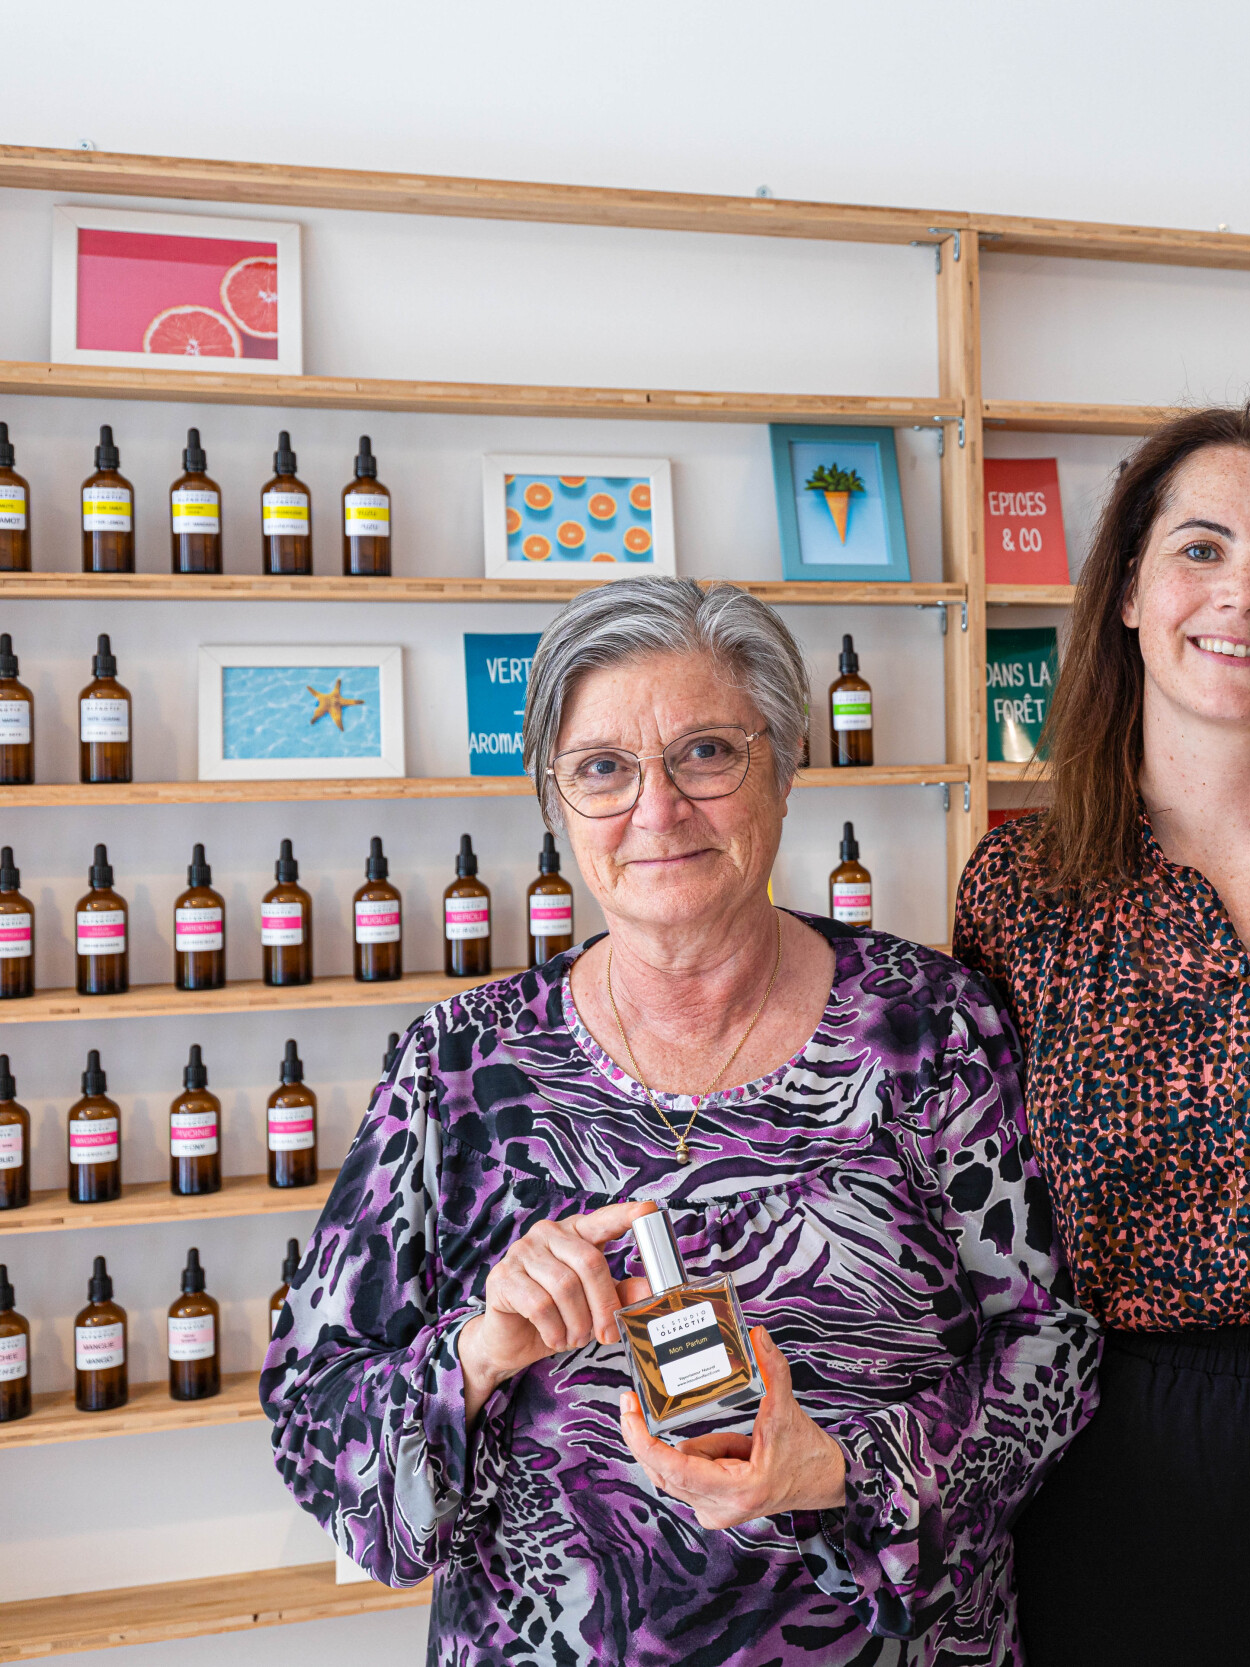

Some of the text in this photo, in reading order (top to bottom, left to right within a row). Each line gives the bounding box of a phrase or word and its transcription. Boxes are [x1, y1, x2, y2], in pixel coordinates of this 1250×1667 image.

[988, 491, 1047, 516] EPICES
[1002, 527, 1042, 553] & CO
[1028, 660, 1052, 687] LA
[993, 692, 1045, 724] FORÊT
[469, 731, 525, 755] AROMA
[660, 1317, 706, 1337] OLFACTIF
[671, 1310, 706, 1326] STUDIO
[668, 1336, 708, 1355] Mon Parfum
